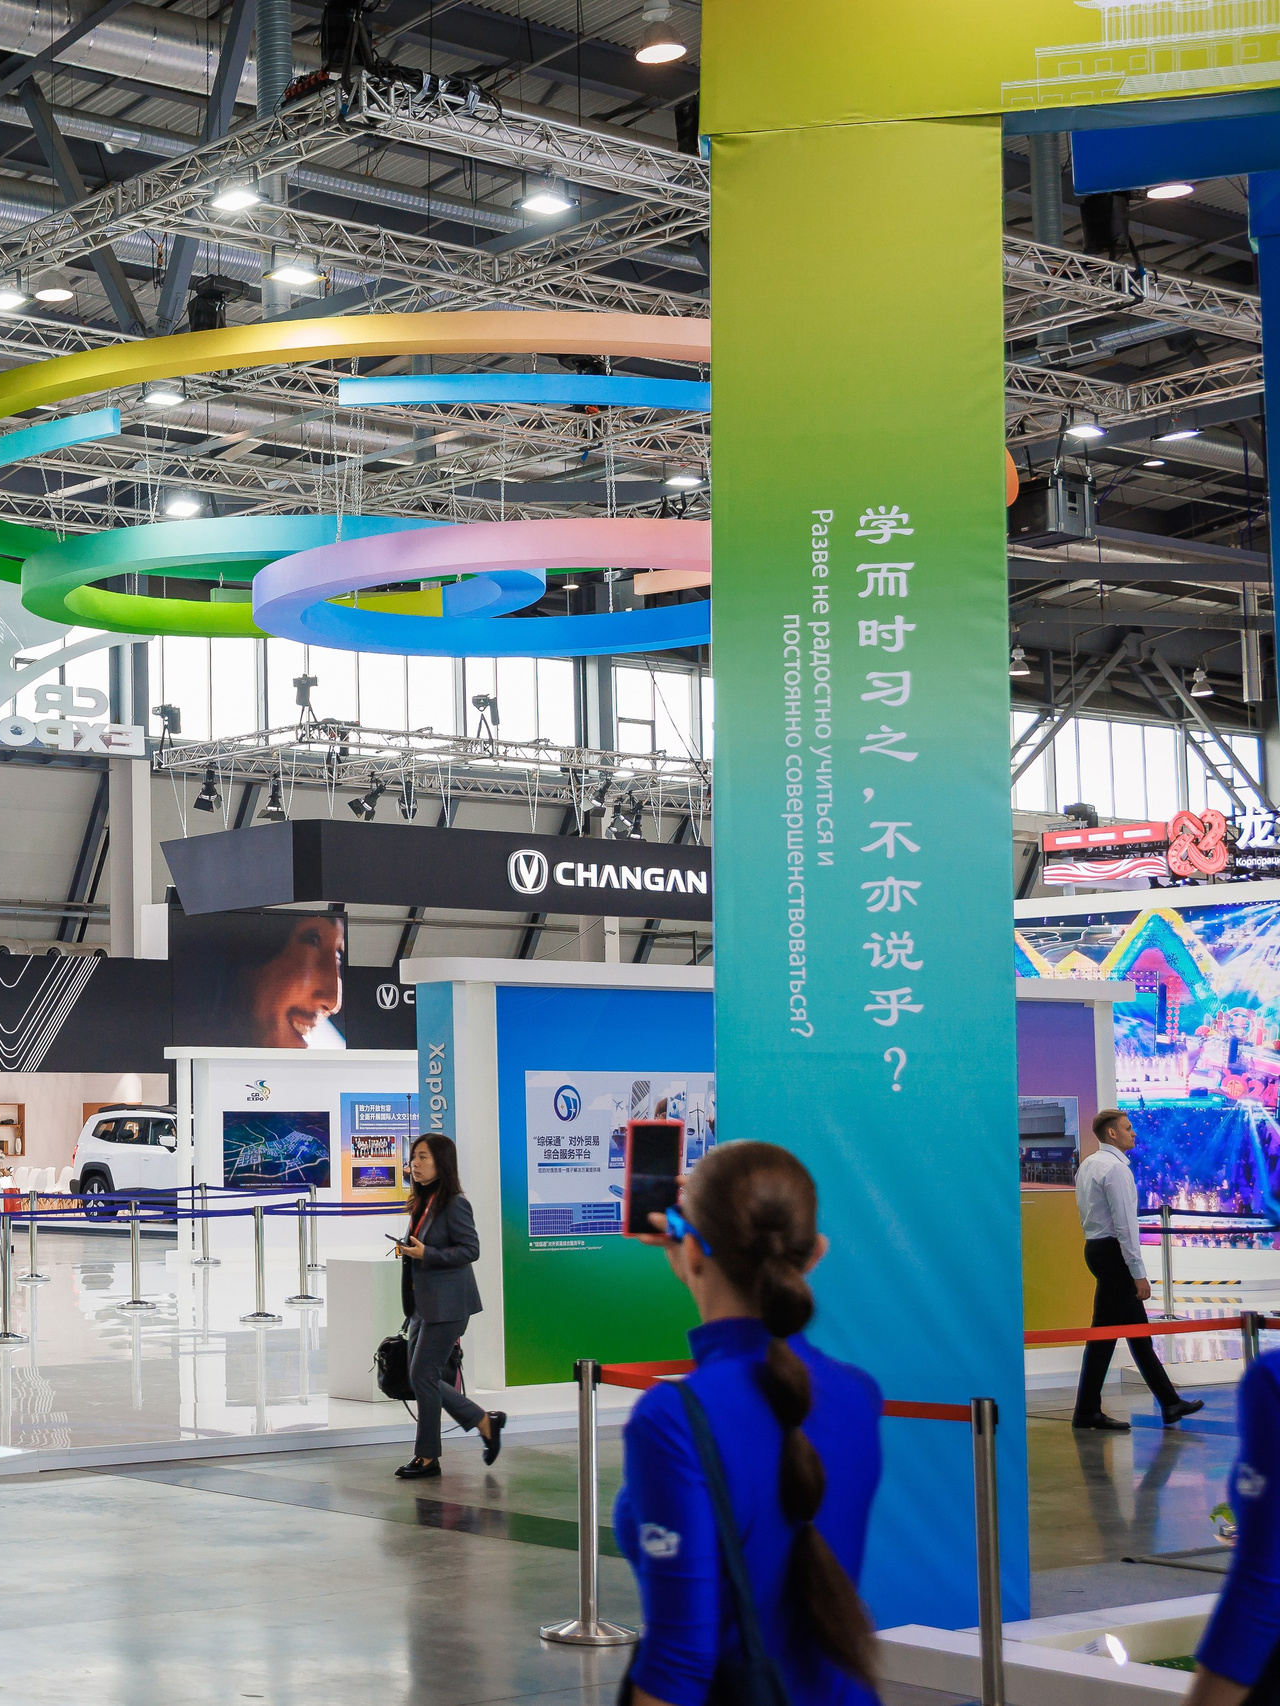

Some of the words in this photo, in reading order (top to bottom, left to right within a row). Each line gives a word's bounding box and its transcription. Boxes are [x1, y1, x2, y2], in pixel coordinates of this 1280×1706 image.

[811, 509, 834, 578] Разве
[812, 585, 830, 614] не
[783, 614, 802, 748] постоянно
[807, 621, 831, 739] радостно
[809, 744, 834, 844] учиться
[855, 505, 924, 1092] 学而时习之，不亦说乎？
[553, 862, 708, 894] CHANGAN
[781, 754, 814, 1038] совершенствоваться?
[817, 851, 834, 866] и
[425, 1042, 448, 1136] Харби
[543, 1149, 591, 1160] 综合服务平台
[569, 1136, 600, 1147] 对外贸易
